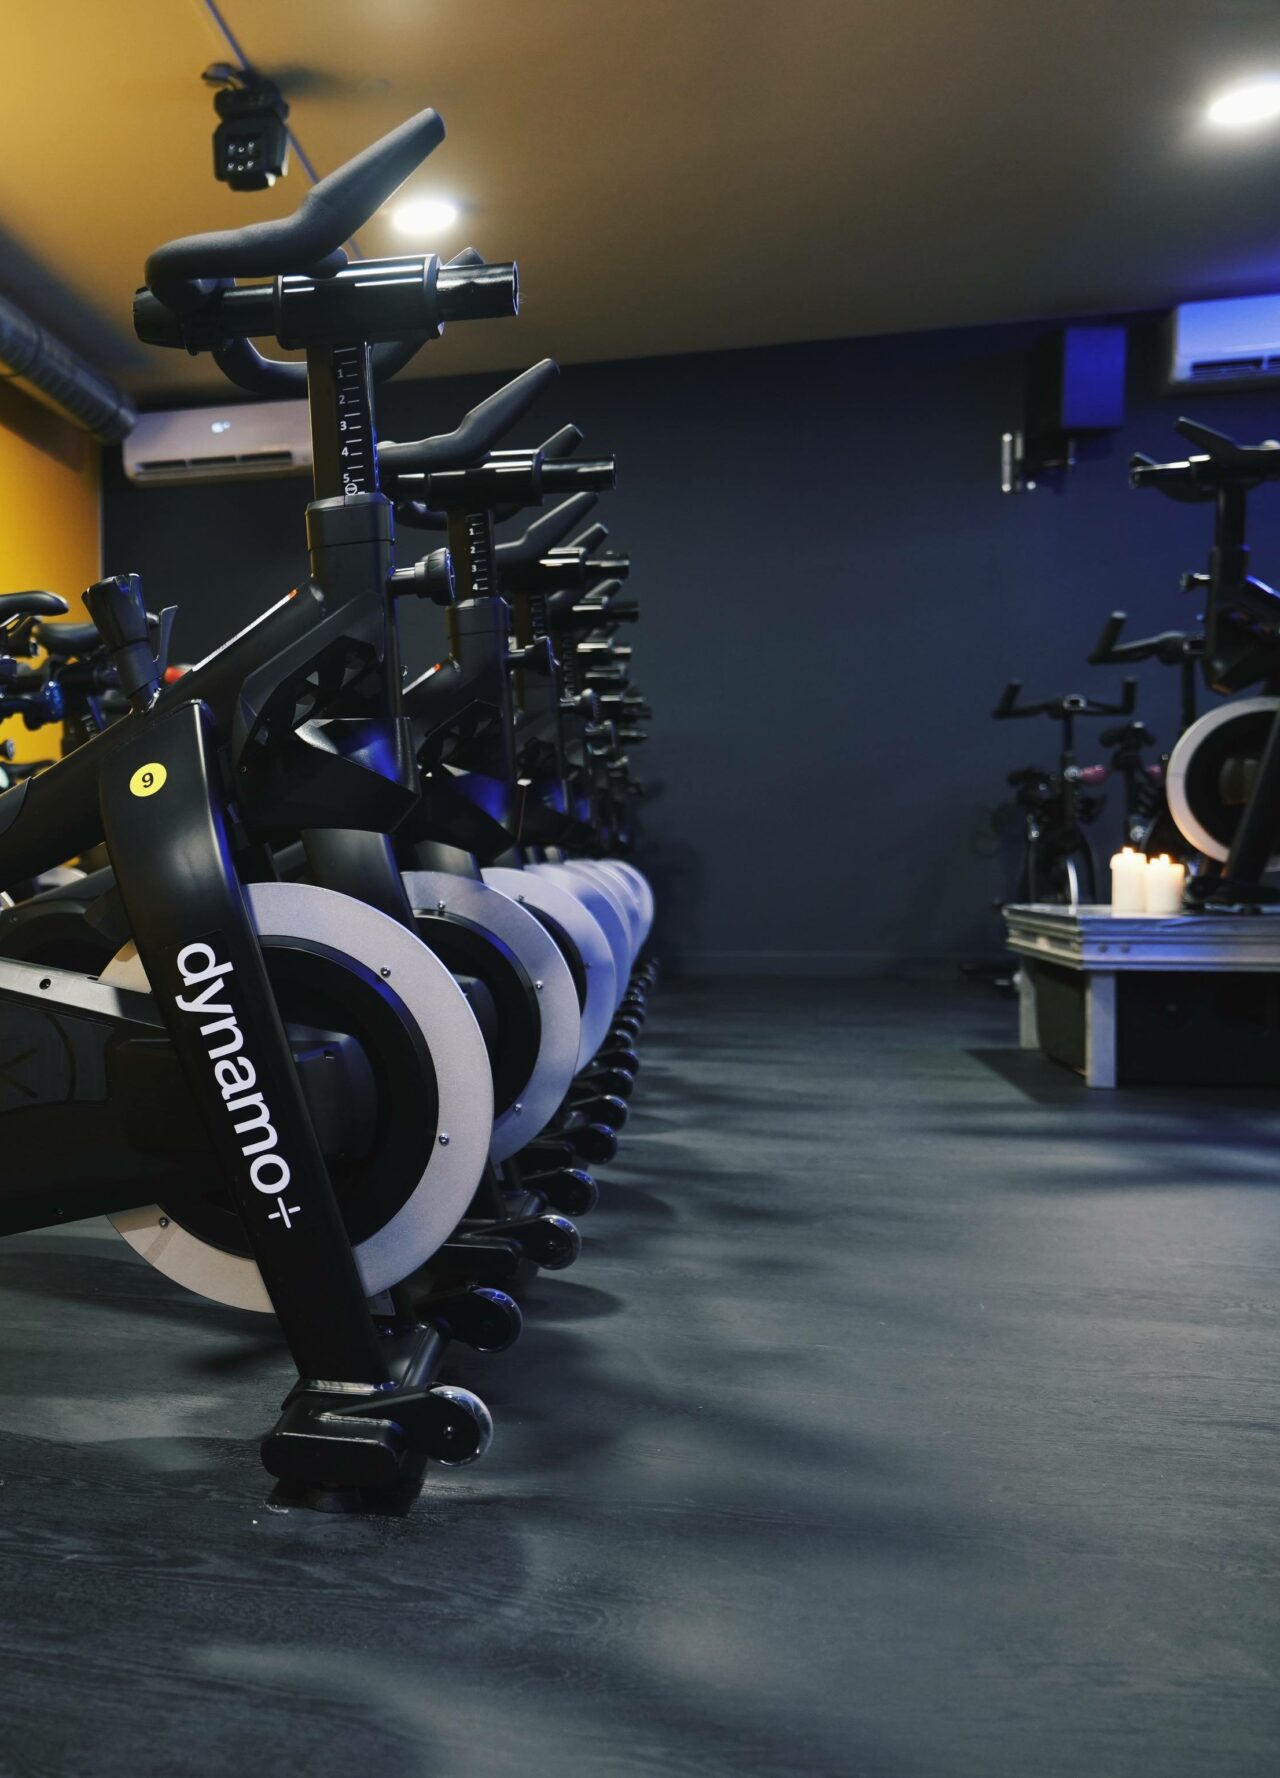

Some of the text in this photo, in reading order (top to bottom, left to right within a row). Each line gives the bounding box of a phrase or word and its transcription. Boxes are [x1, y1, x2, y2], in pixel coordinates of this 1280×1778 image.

[337, 368, 344, 378] 1
[338, 394, 346, 405] 2
[340, 420, 347, 431] 3
[341, 446, 349, 457] 4
[343, 473, 350, 484] 5
[469, 527, 474, 536] 1
[470, 546, 476, 554] 2
[471, 564, 477, 573] 3
[472, 583, 478, 591] 4
[141, 772, 154, 788] 9
